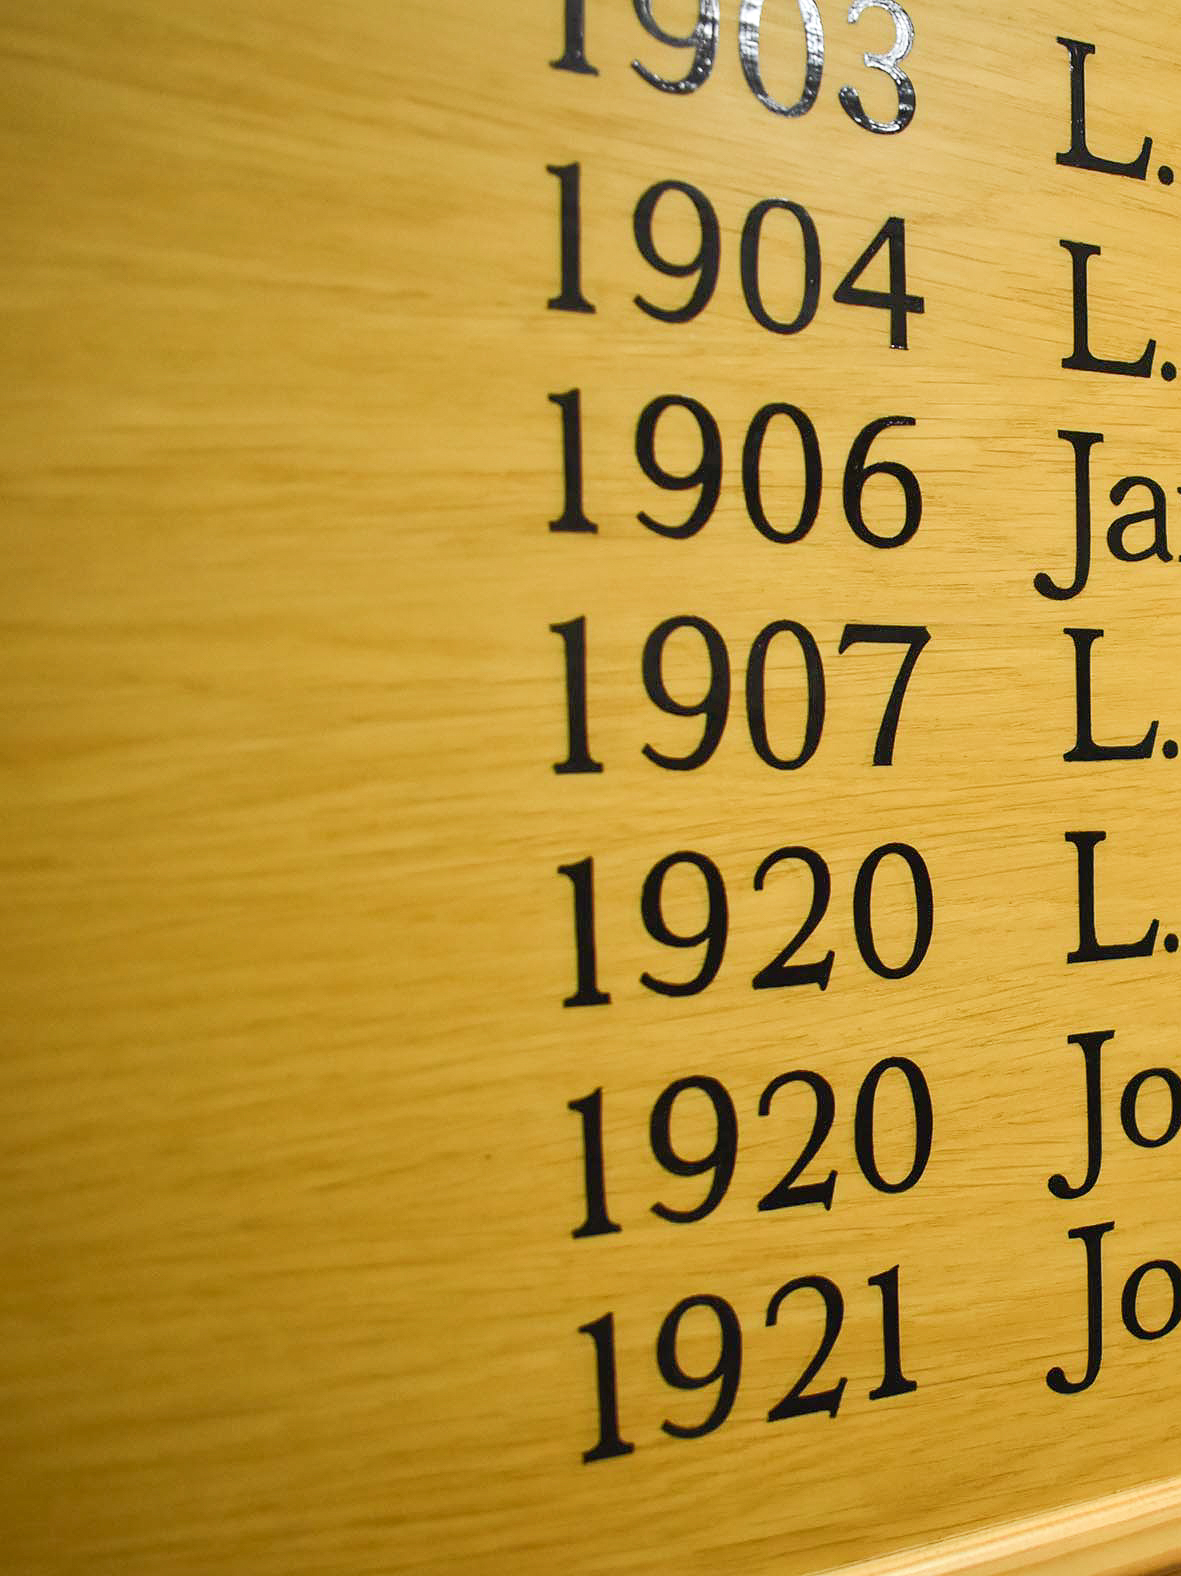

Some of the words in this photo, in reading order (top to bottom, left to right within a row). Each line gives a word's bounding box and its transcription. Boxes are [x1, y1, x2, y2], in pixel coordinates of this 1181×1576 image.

[548, 0, 918, 136] 1903
[1055, 36, 1175, 187] L.
[546, 161, 926, 351] 1904
[1058, 239, 1178, 383] L.
[547, 387, 924, 550] 1906
[549, 614, 933, 775] 1907
[1062, 627, 1180, 761] L.
[557, 841, 935, 1009] 1920
[1064, 830, 1180, 965] L.
[566, 1056, 935, 1240] 1920
[577, 1264, 920, 1466] 1921
